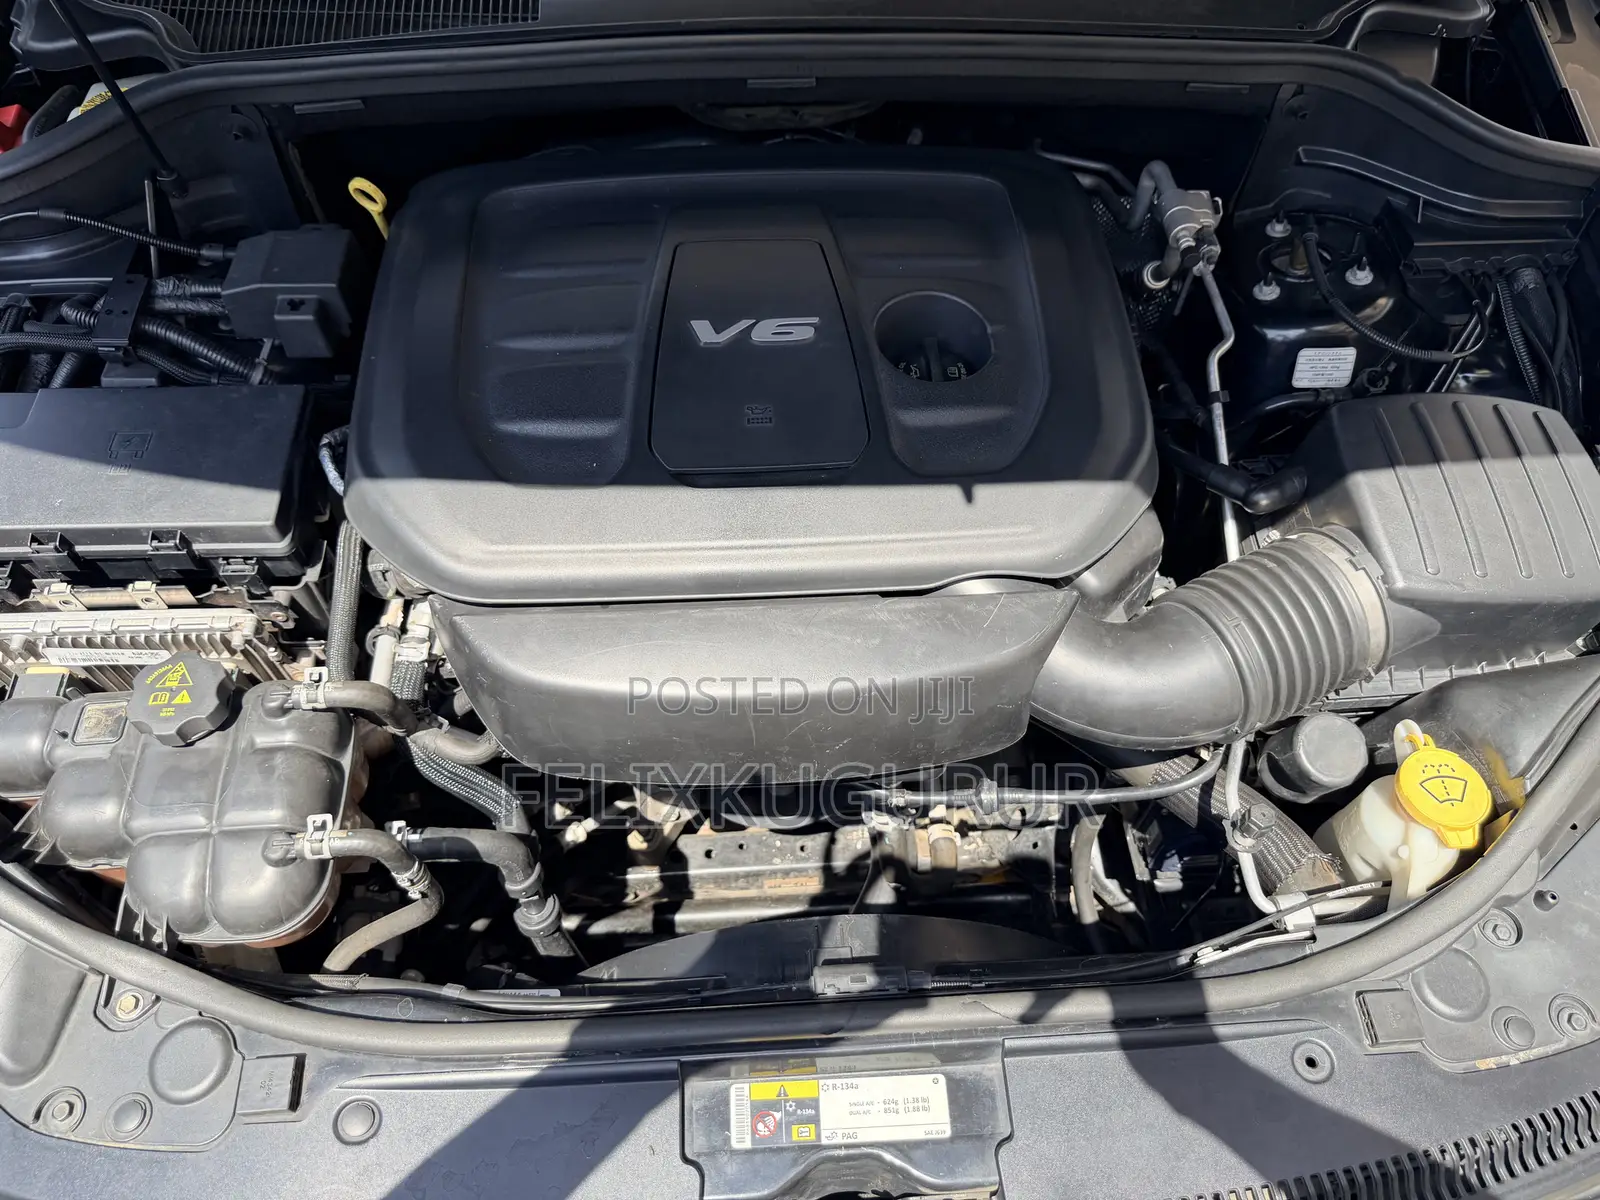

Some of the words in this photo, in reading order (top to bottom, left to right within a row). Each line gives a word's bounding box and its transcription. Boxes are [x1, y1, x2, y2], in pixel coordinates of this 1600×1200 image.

[689, 317, 820, 346] V6
[832, 1082, 859, 1091] R-134a
[882, 1098, 899, 1106] 624g
[903, 1097, 920, 1105] (1.38
[921, 1096, 930, 1104] lb)
[883, 1107, 900, 1115] 851g
[904, 1105, 921, 1114] (1.88
[921, 1104, 931, 1113] lb)
[841, 1131, 858, 1140] PAG
